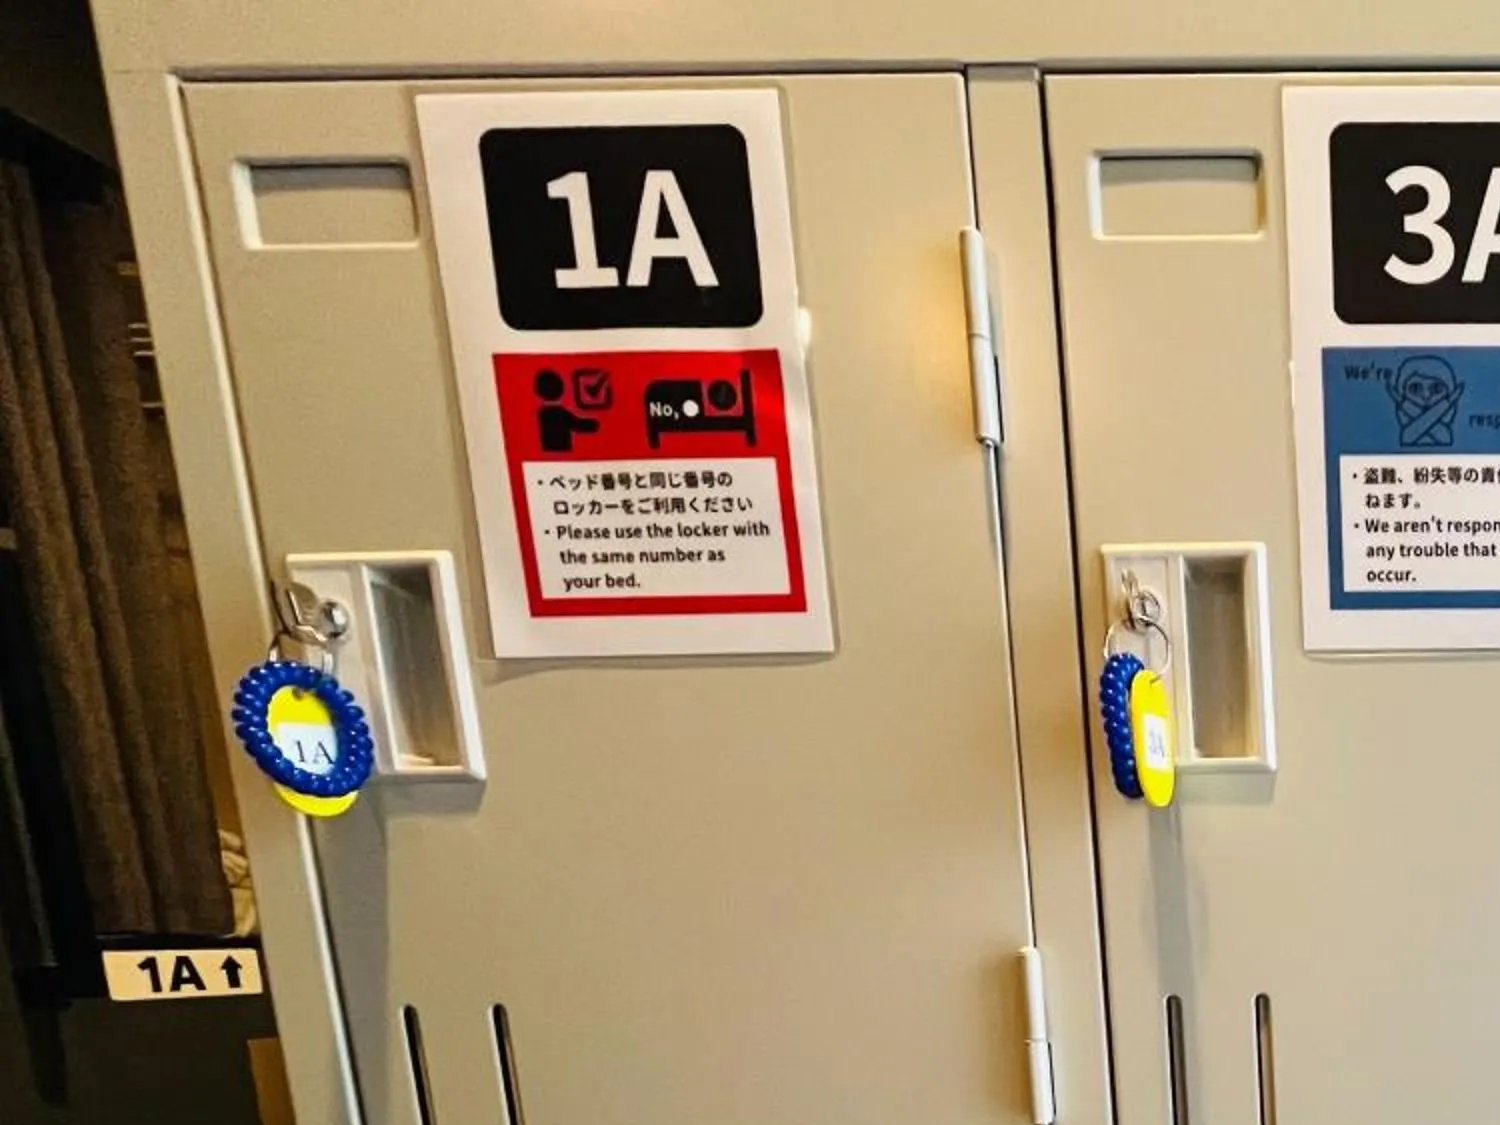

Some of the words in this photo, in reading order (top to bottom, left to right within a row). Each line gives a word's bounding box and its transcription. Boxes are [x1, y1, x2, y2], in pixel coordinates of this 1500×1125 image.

[546, 169, 720, 290] 1A
[557, 525, 610, 539] Please
[615, 527, 642, 539] use
[646, 525, 672, 538] the
[678, 522, 728, 537] locker
[733, 521, 770, 537] with
[1365, 519, 1389, 533] We
[1394, 516, 1443, 533] aren't
[560, 551, 587, 564] the
[592, 552, 634, 564] same
[640, 548, 702, 563] number
[708, 550, 725, 561] as
[1366, 545, 1395, 560] any
[1400, 543, 1458, 557] trouble
[1464, 543, 1496, 556] that
[564, 575, 601, 592] your
[606, 573, 641, 588] bed.
[1367, 570, 1417, 582] occur.
[137, 955, 206, 993] 1A
